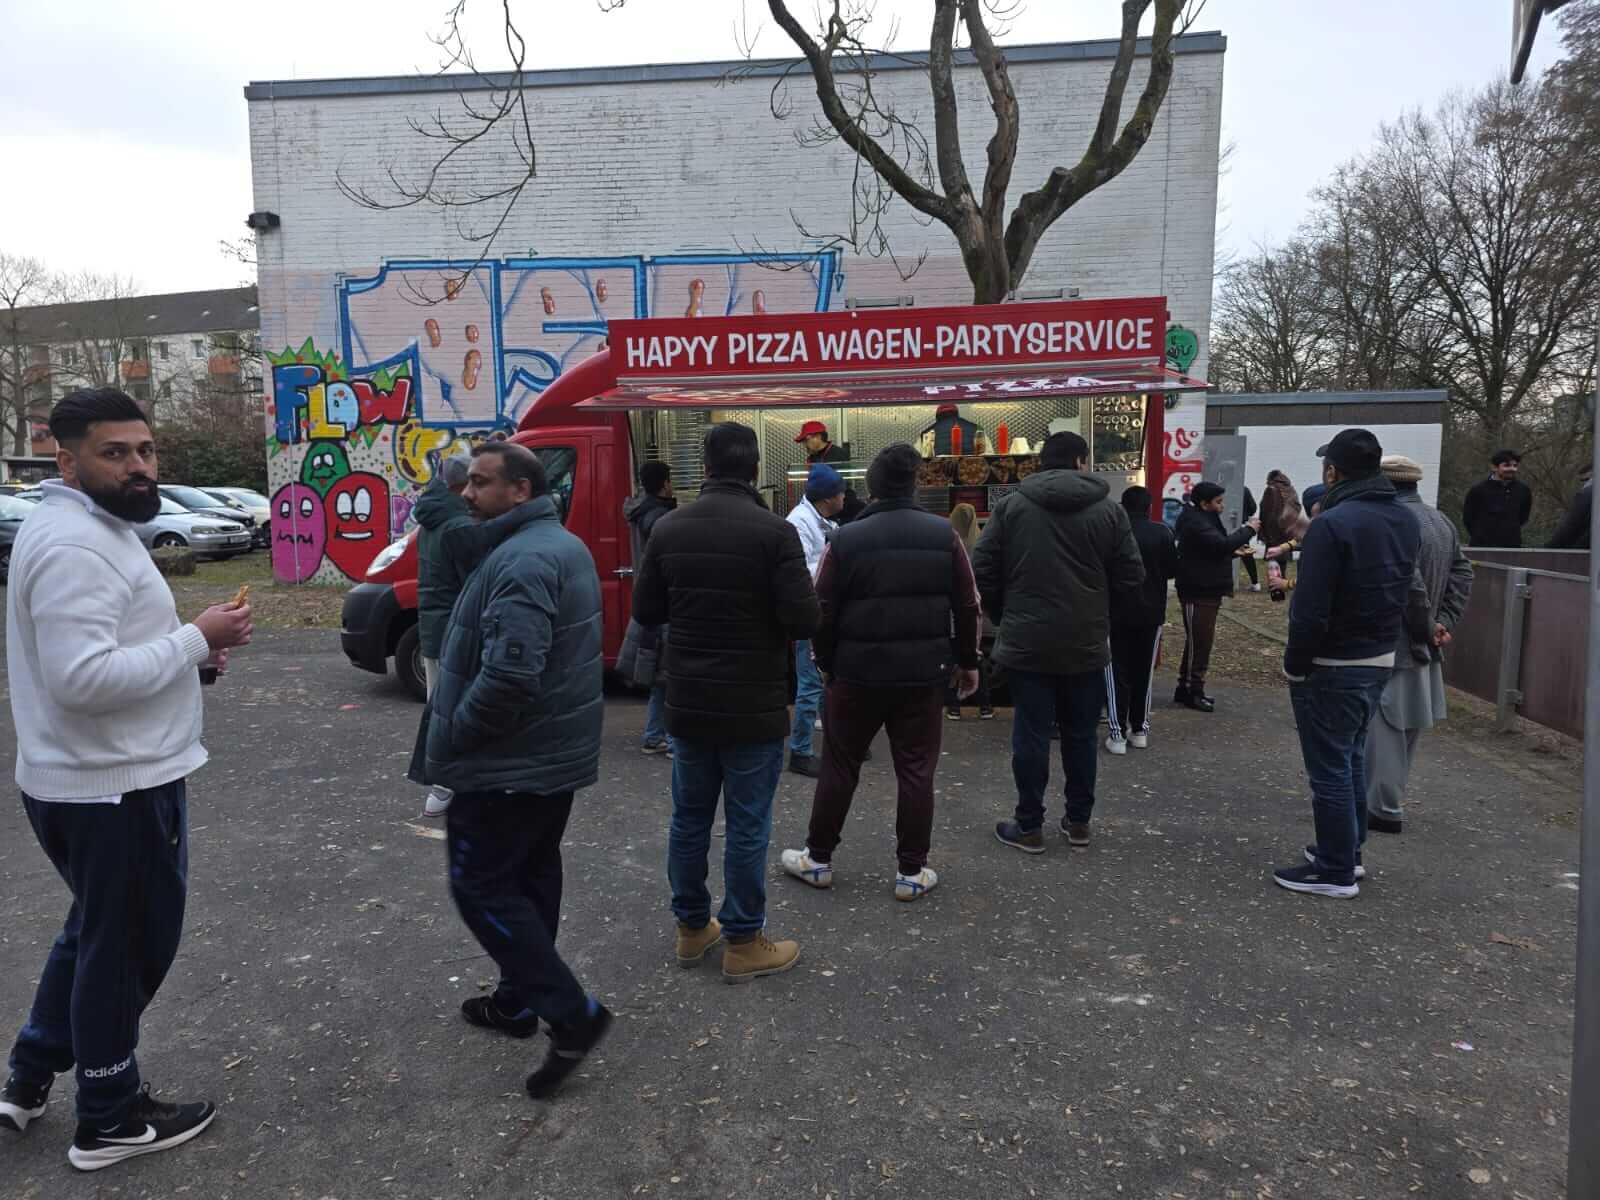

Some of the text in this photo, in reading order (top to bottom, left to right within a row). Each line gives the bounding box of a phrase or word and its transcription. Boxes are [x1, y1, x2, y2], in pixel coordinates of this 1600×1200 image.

[625, 317, 1154, 369] HAPYY PIZZA WAGEN-PARTYSERVICE
